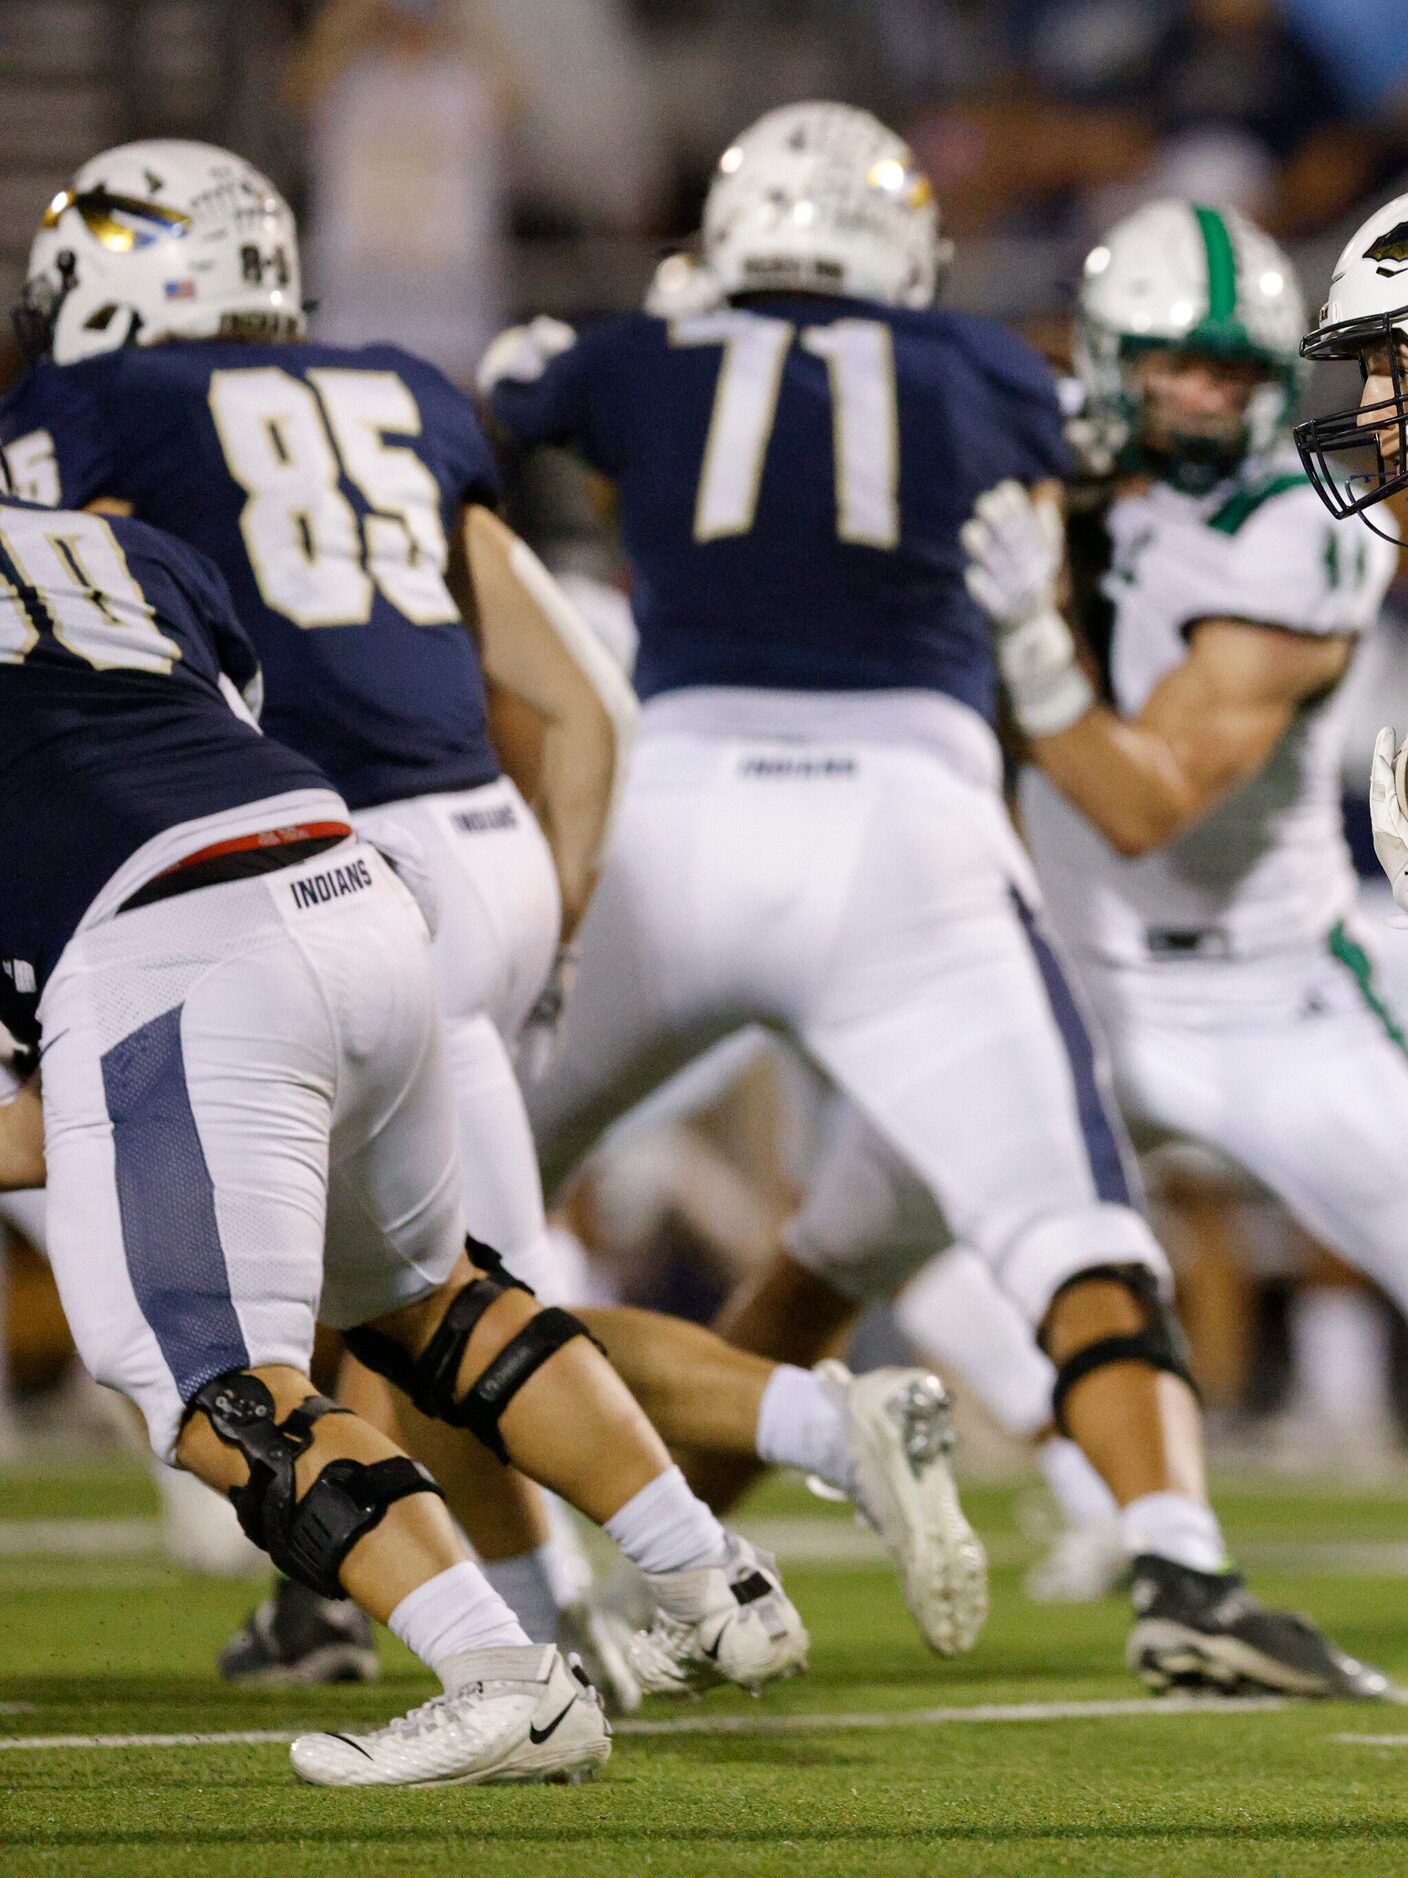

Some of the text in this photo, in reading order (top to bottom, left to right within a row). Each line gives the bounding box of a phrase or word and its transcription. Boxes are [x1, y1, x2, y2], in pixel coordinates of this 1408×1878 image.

[0, 428, 62, 508] 5
[208, 366, 461, 629] 85
[667, 311, 900, 550] 71
[289, 858, 373, 910] INDIANS
